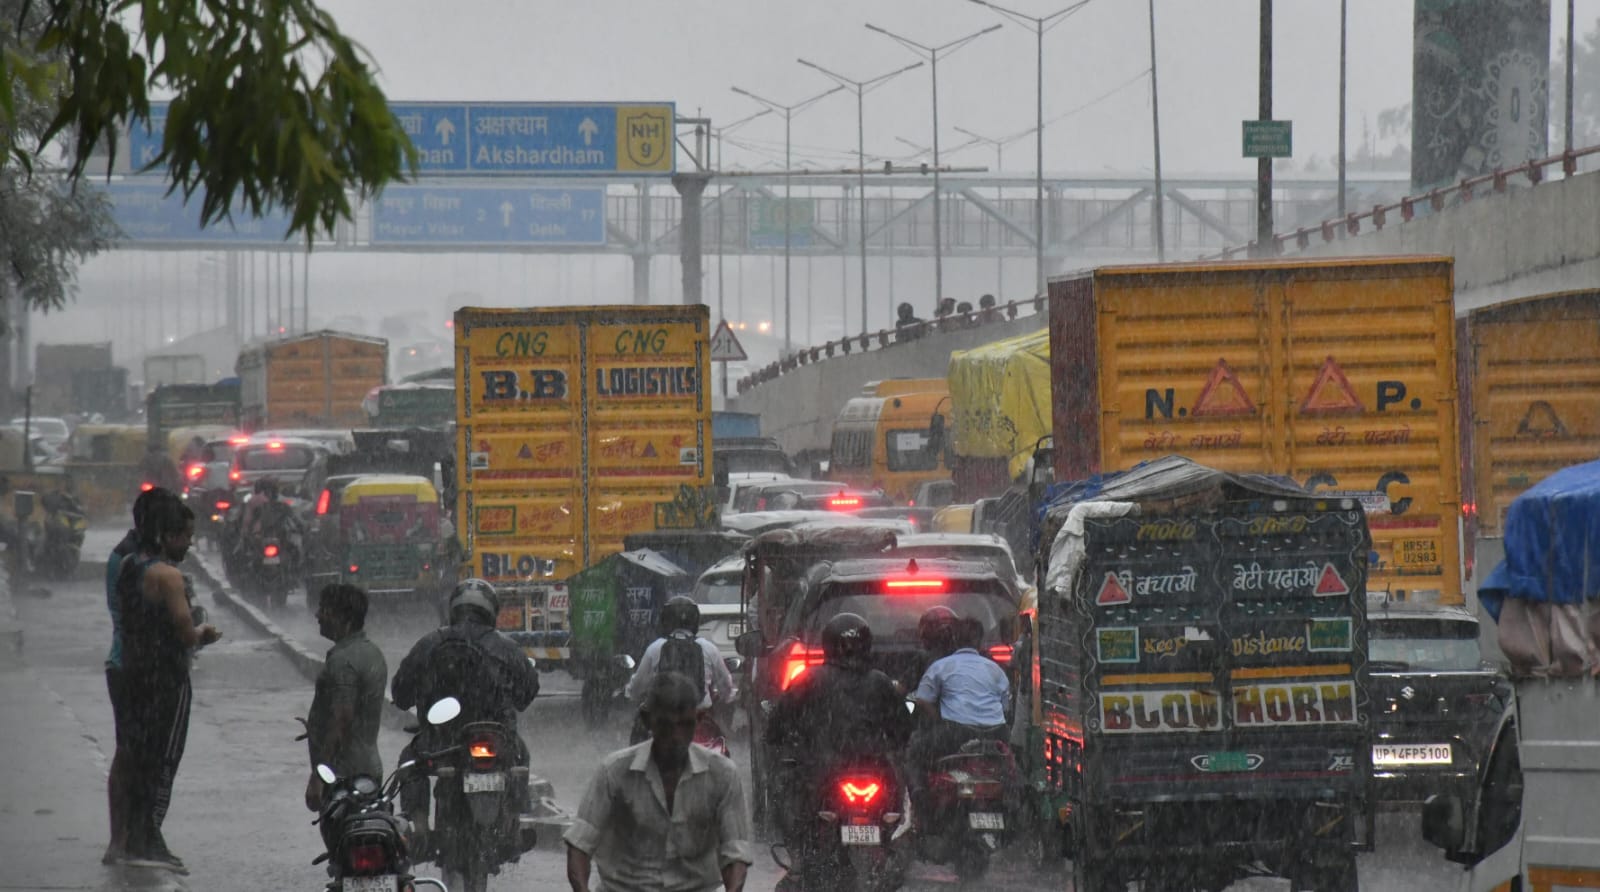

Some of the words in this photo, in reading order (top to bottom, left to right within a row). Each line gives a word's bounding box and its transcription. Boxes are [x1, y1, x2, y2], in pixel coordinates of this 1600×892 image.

[632, 122, 658, 138] NH
[476, 145, 604, 165] Akshardham
[641, 141, 651, 158] 9
[496, 331, 549, 357] CNG
[615, 329, 668, 353] CNG
[481, 369, 568, 401] B.B
[596, 366, 697, 396] LOGISTICS
[1136, 566, 1198, 595] बचाओ
[1233, 561, 1264, 591] बेटी
[549, 594, 569, 609] KEE
[1144, 636, 1187, 659] Keep
[1232, 631, 1306, 657] Distance
[1102, 691, 1220, 730] BLOW
[1233, 683, 1355, 725] HORN
[1375, 747, 1449, 760] UP14FP5100
